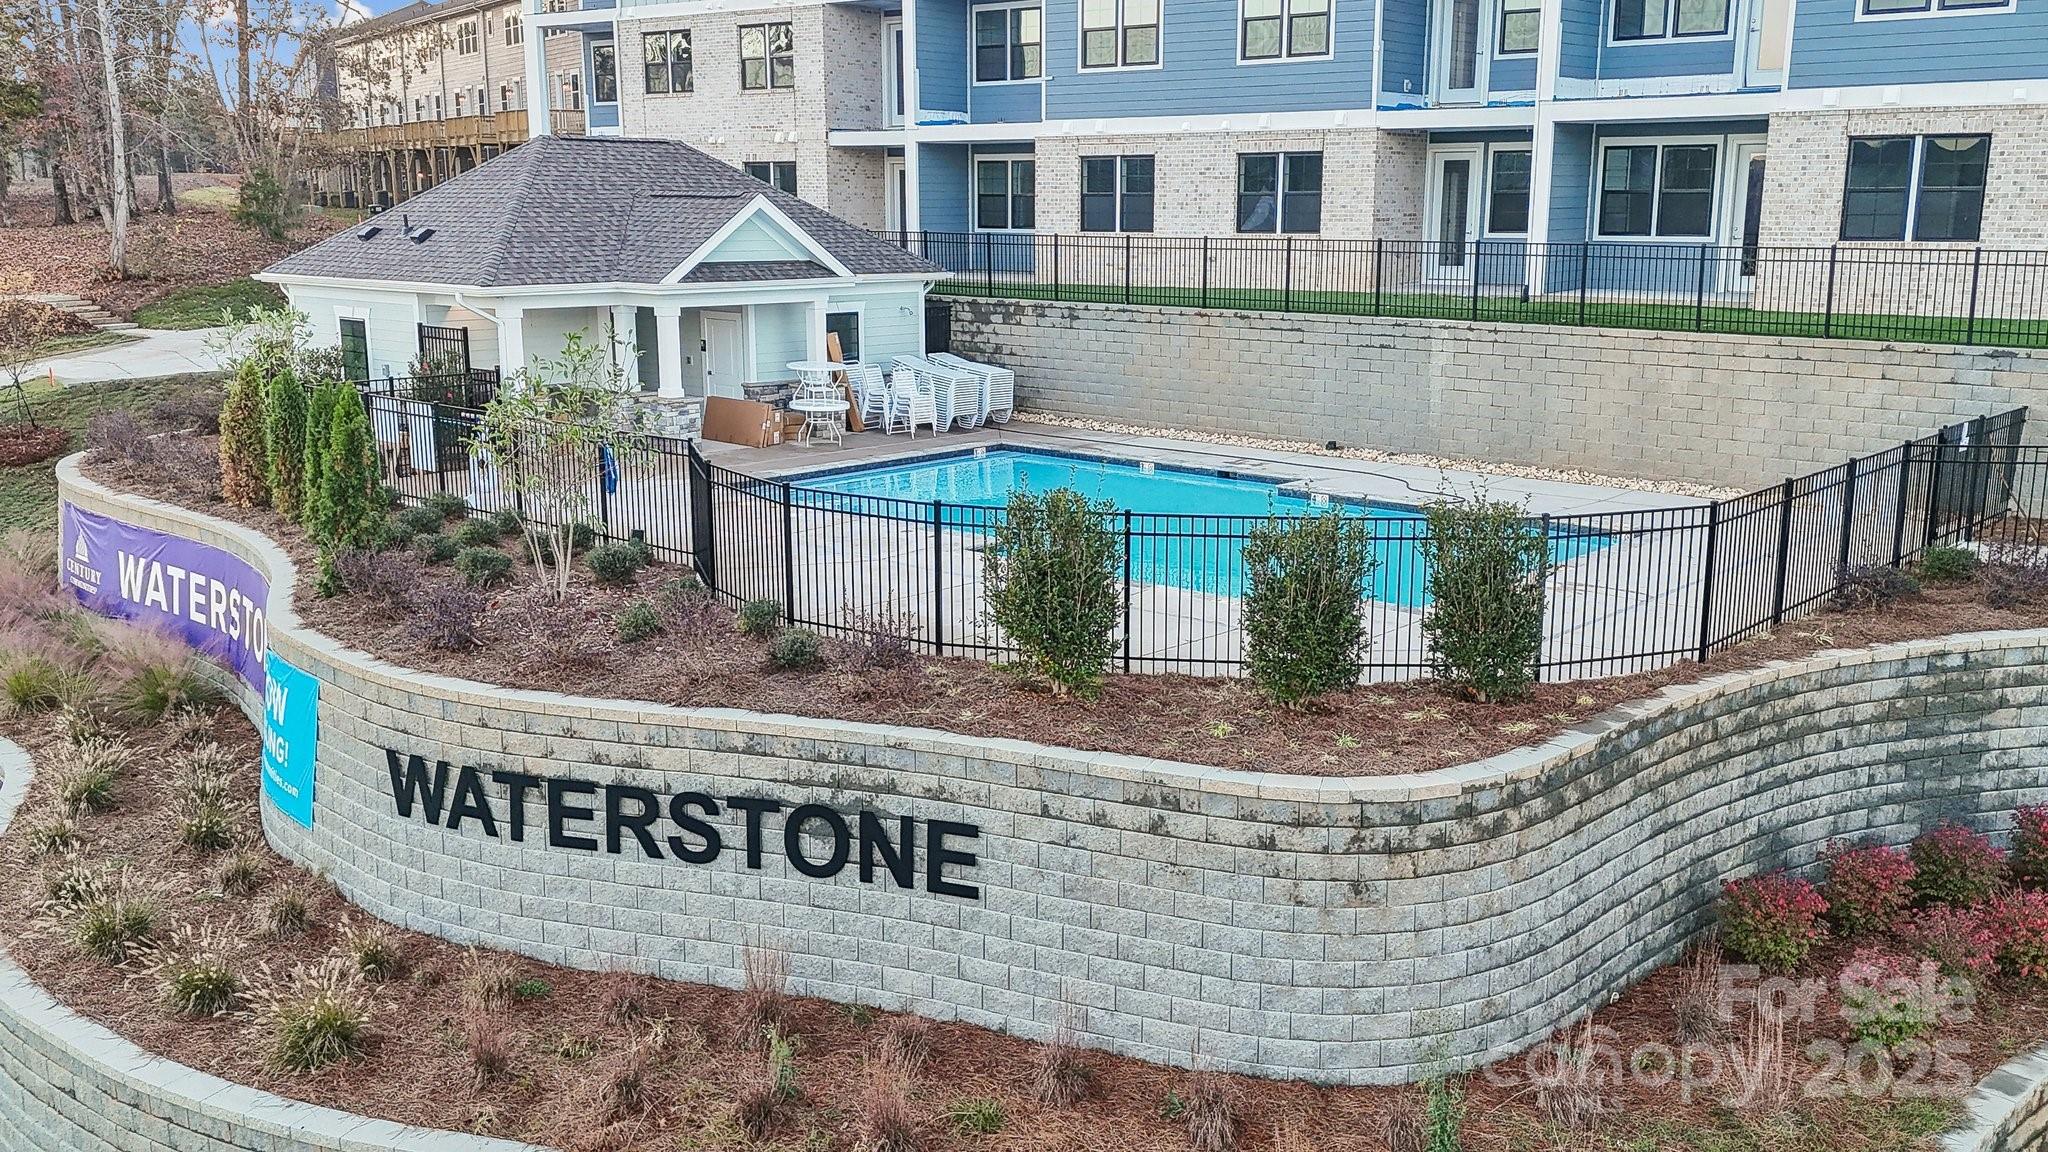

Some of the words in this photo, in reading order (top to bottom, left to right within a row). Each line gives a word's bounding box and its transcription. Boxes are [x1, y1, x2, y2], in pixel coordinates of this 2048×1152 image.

[66, 558, 102, 586] CENTURY
[117, 549, 267, 668] WATERSTO
[265, 673, 289, 726] OW
[385, 748, 980, 900] WATERSTONE
